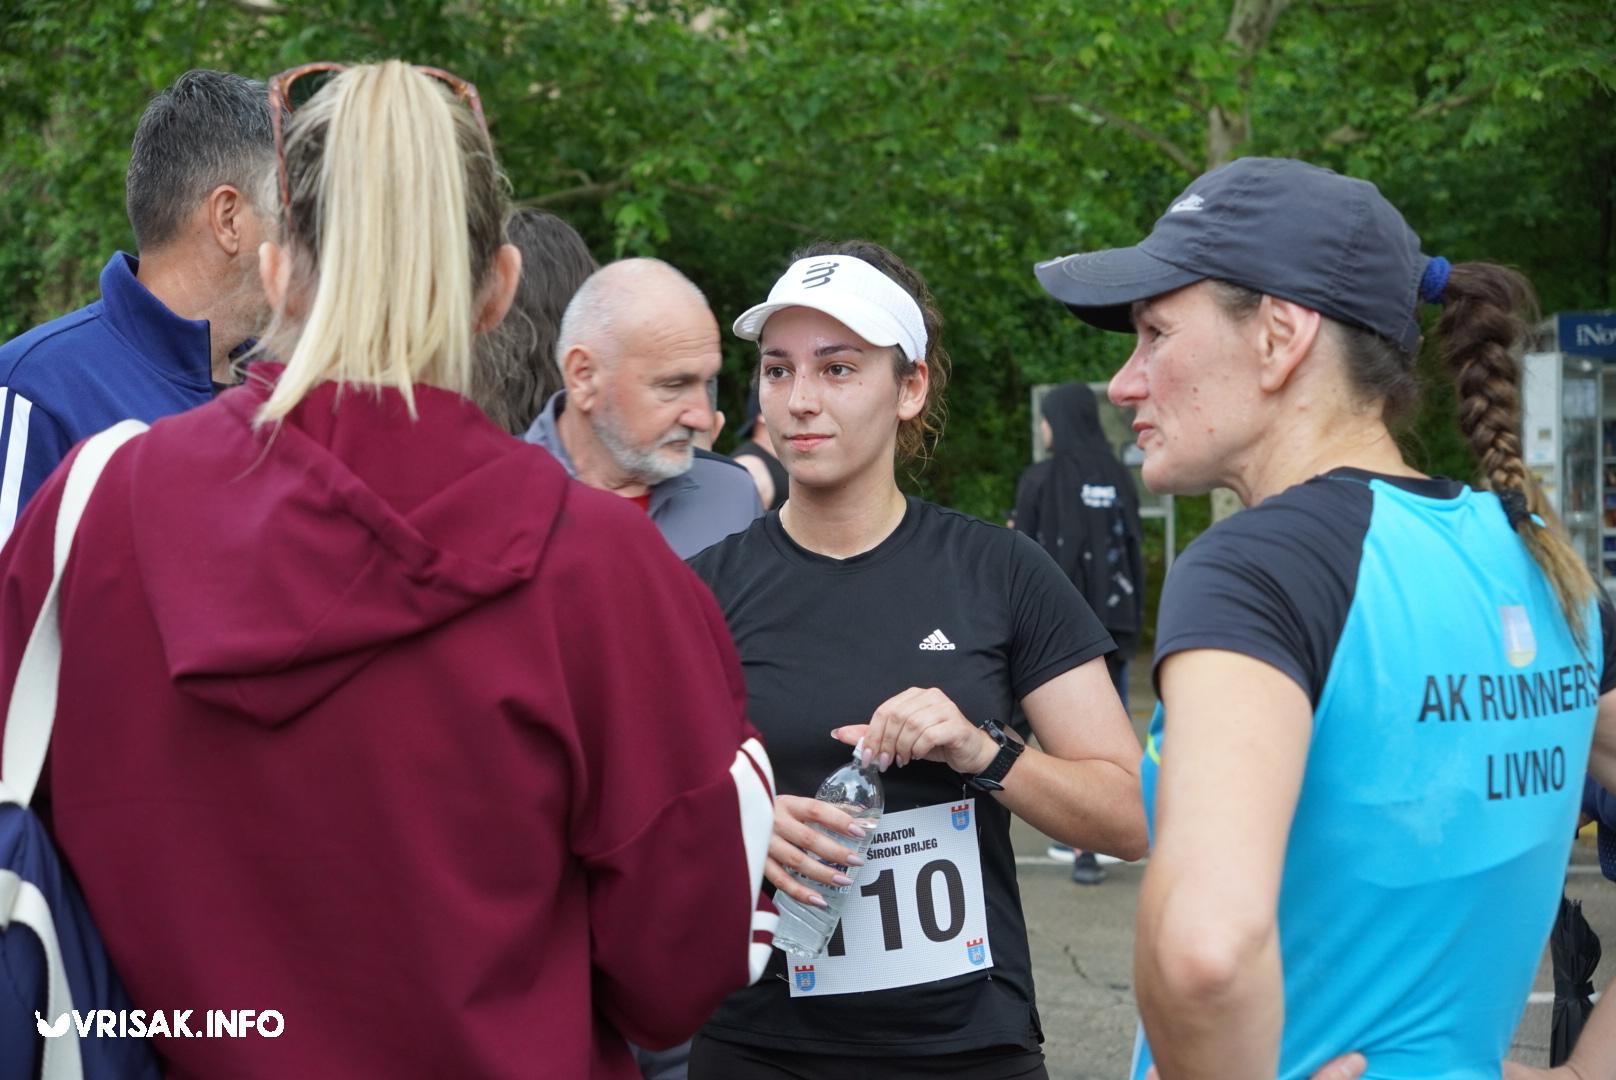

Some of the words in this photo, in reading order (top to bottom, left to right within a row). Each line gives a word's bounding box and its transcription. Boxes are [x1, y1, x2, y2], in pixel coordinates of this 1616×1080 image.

[919, 641, 956, 651] adidas
[1418, 673, 1471, 722] AK
[1478, 663, 1598, 721] RUNNERS
[1487, 746, 1566, 801] LIVNO
[866, 845, 902, 861] ŠIROKI
[904, 838, 938, 855] BRIJEG
